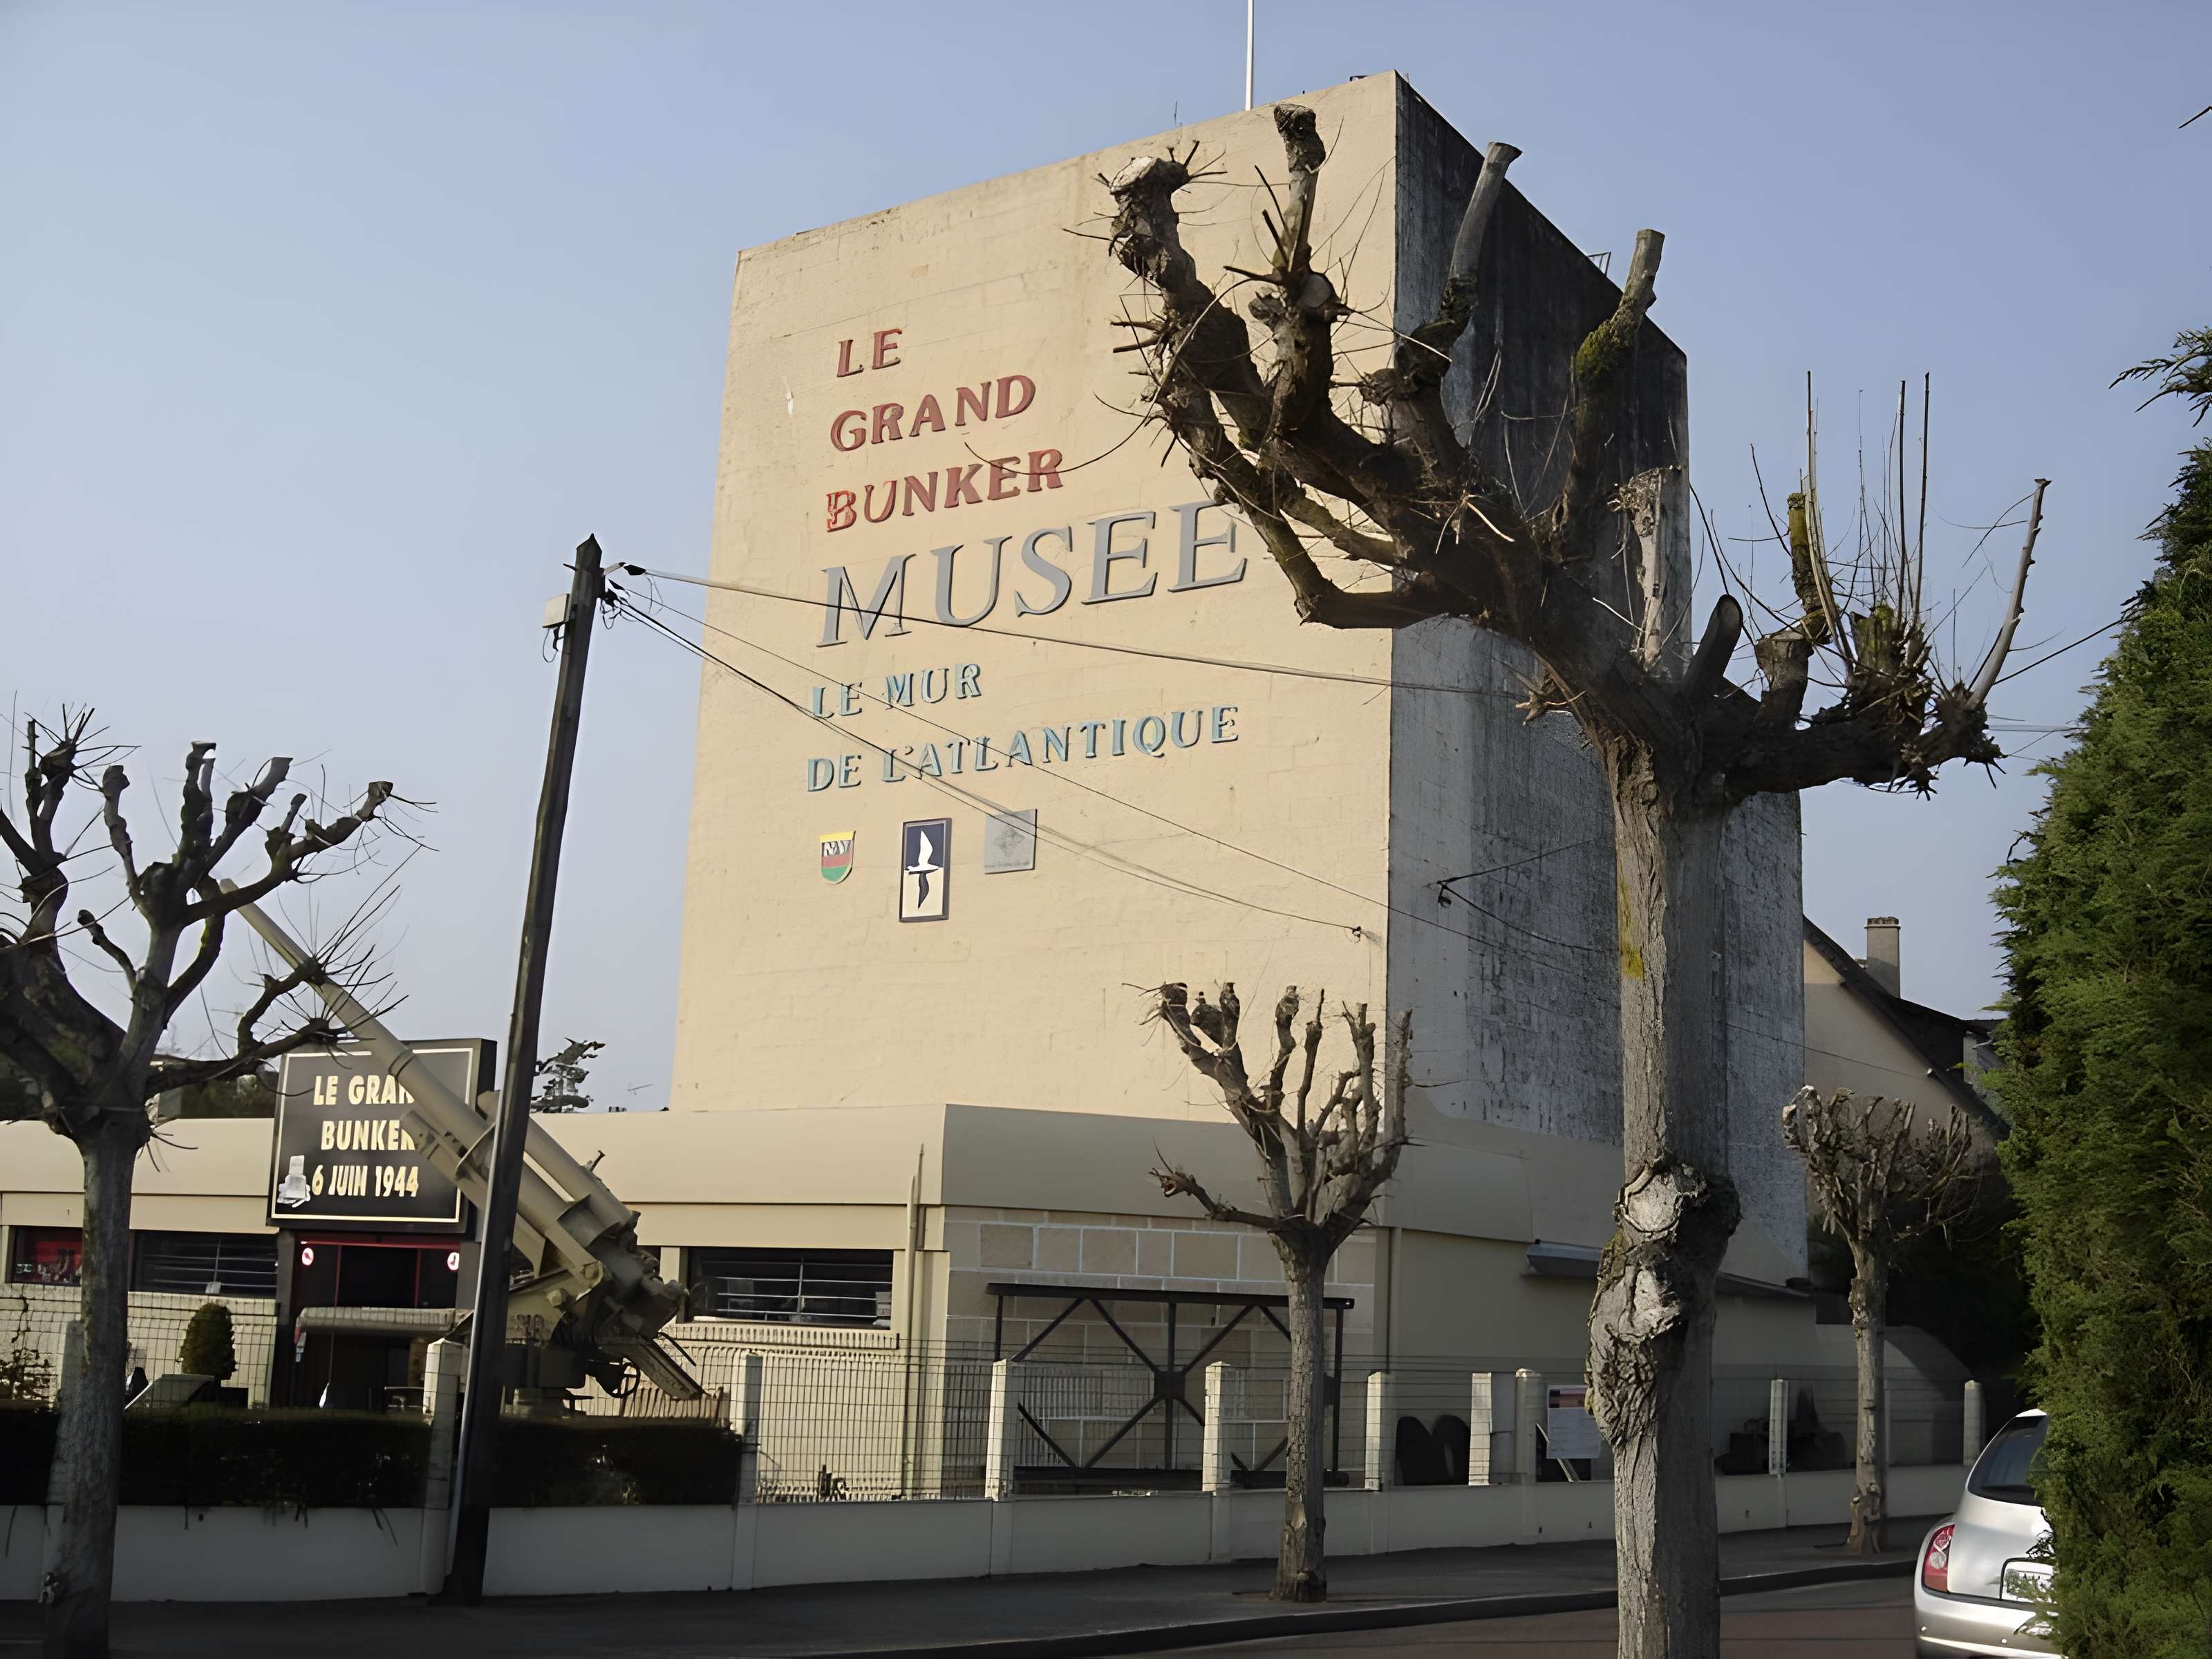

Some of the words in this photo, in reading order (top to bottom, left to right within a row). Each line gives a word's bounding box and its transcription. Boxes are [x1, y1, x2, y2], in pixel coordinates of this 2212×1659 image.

[836, 328, 902, 377] LE
[830, 375, 1036, 451] GRAND
[825, 448, 1063, 532] BUNKER
[816, 499, 1248, 648] MUSEE
[812, 682, 863, 720] LE
[885, 664, 982, 710] MUR
[807, 754, 861, 792] DE
[881, 706, 1239, 782] L'ATLANTIQUE
[313, 1076, 339, 1105] LE
[348, 1074, 415, 1105] GRAN
[312, 1165, 324, 1196] 6
[328, 1165, 368, 1197] JUIN
[375, 1165, 419, 1197] 1944
